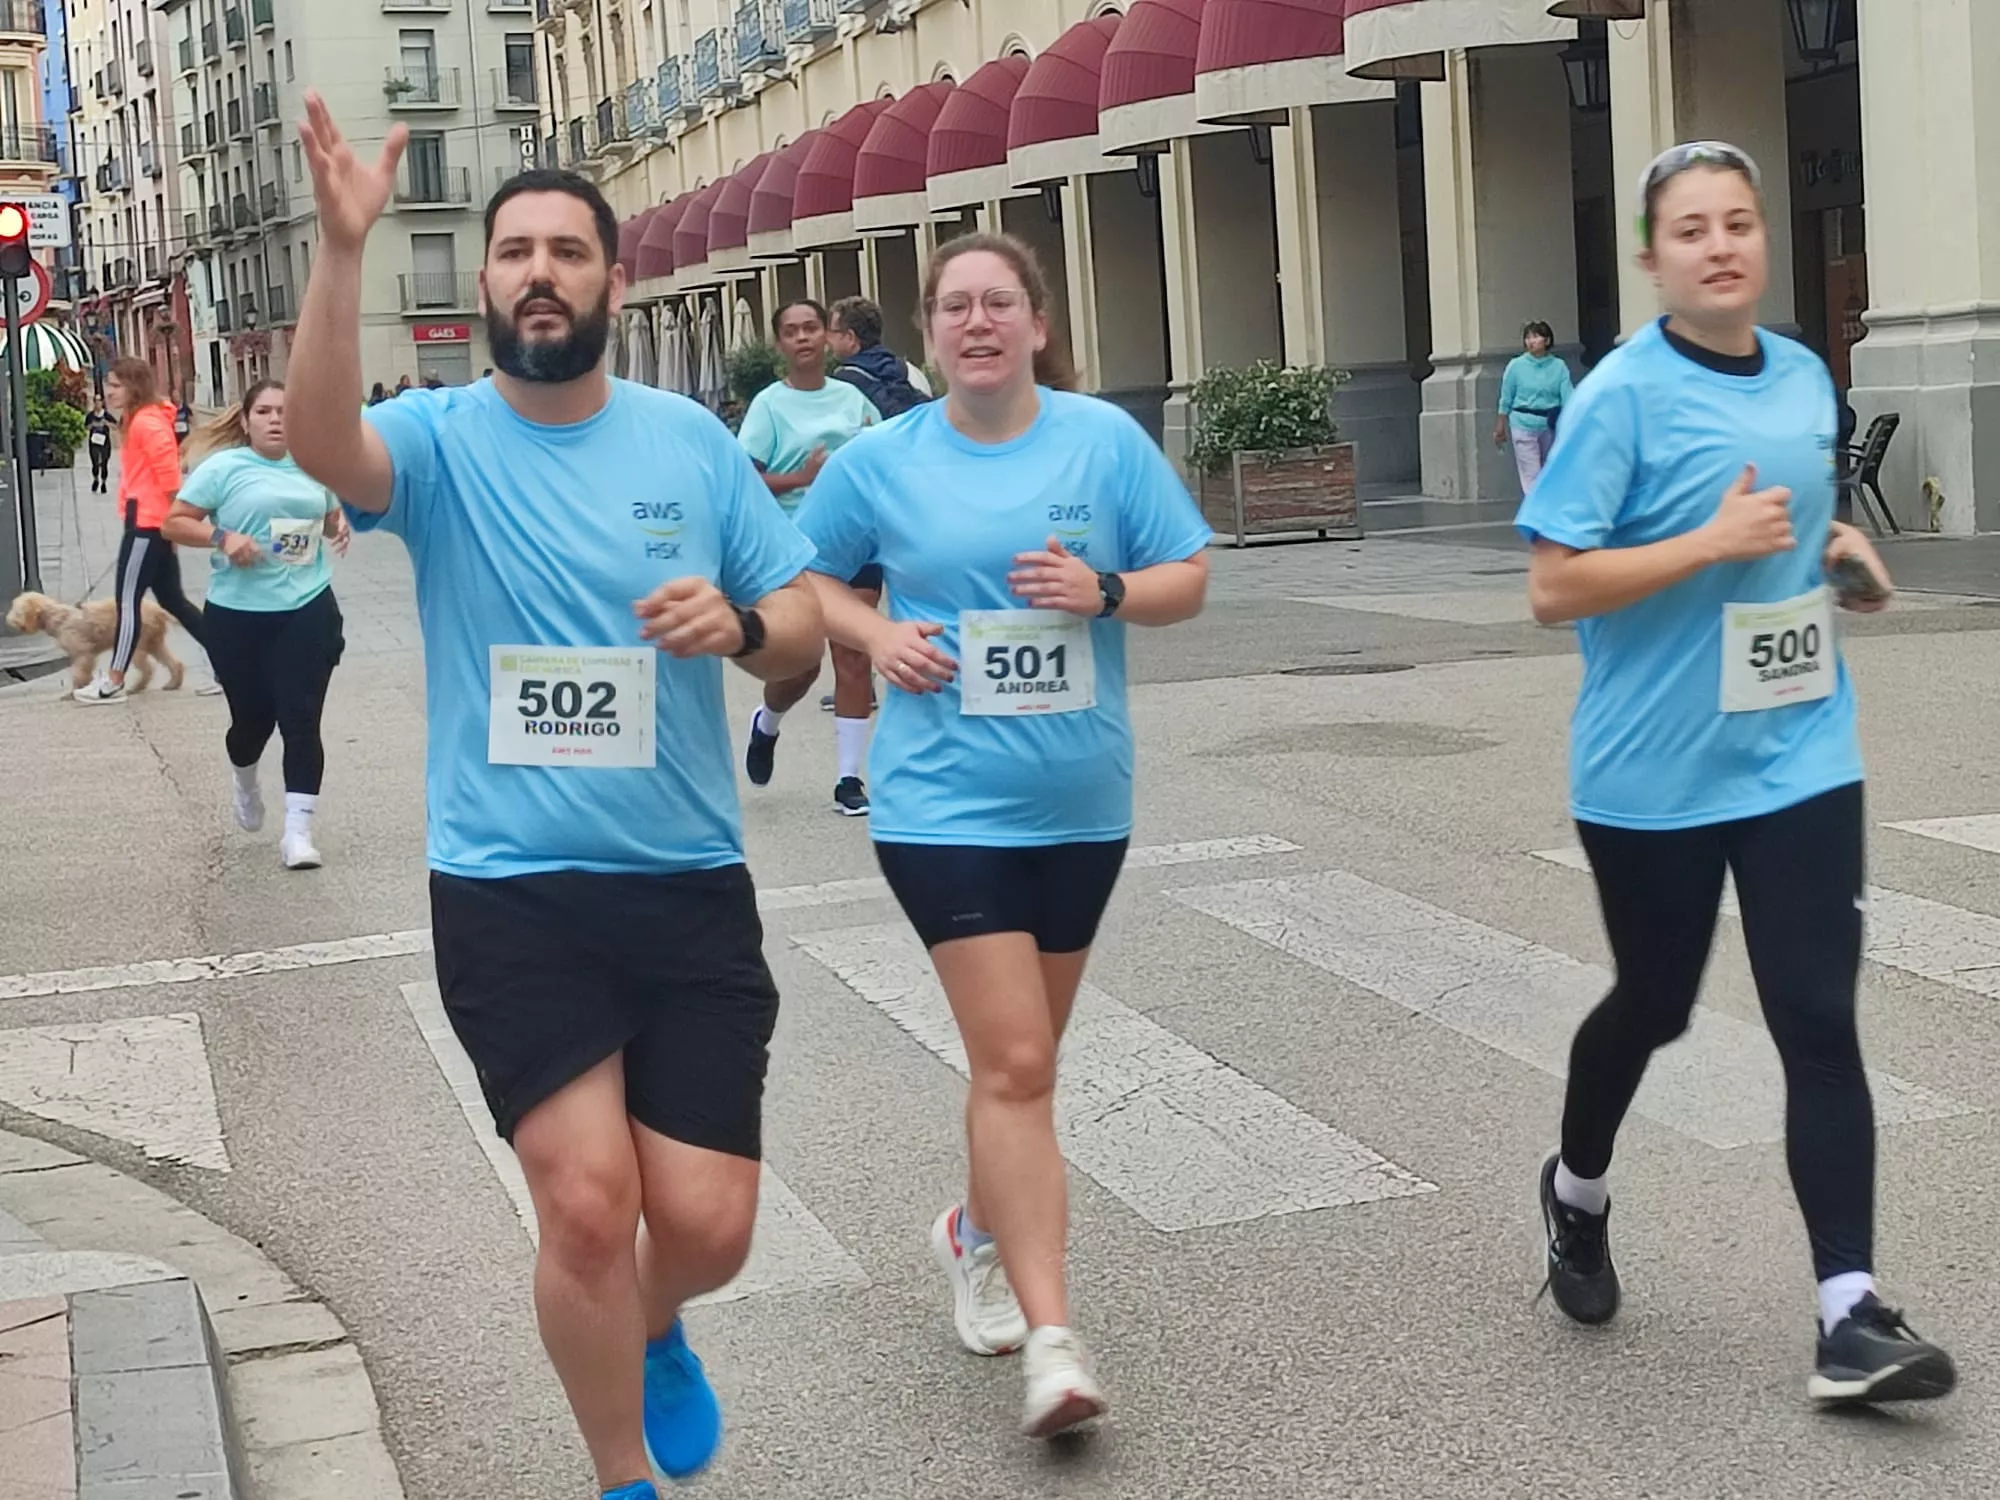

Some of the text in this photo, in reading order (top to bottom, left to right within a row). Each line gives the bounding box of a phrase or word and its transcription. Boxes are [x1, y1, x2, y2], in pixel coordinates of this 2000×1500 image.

[631, 501, 684, 521] aws
[1047, 504, 1091, 522] aws
[1747, 623, 1820, 668] 500
[983, 644, 1067, 680] 501
[995, 679, 1070, 694] ANDREA
[517, 679, 617, 719] 502
[524, 720, 621, 736] RODRIGO
